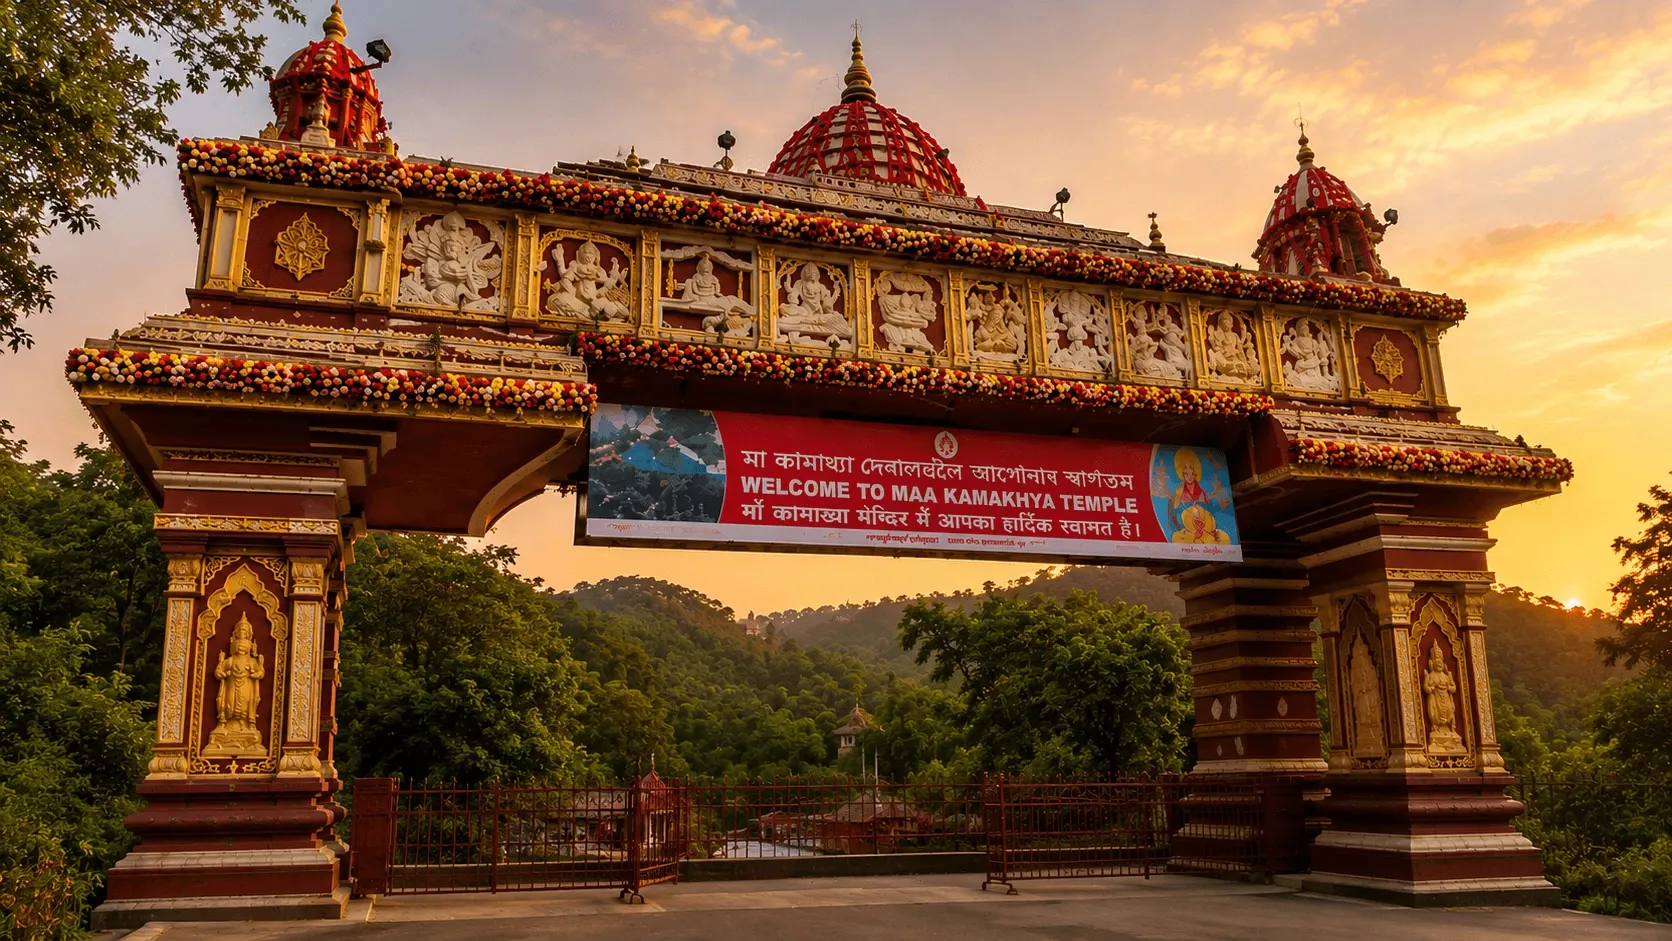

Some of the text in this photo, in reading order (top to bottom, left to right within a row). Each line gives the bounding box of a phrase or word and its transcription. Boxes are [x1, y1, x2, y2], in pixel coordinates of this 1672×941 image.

[741, 451, 767, 468] মা
[741, 476, 1138, 513] WELCOME TO MAA KAMAKHYA TEMPLE
[938, 514, 995, 530] आपका
